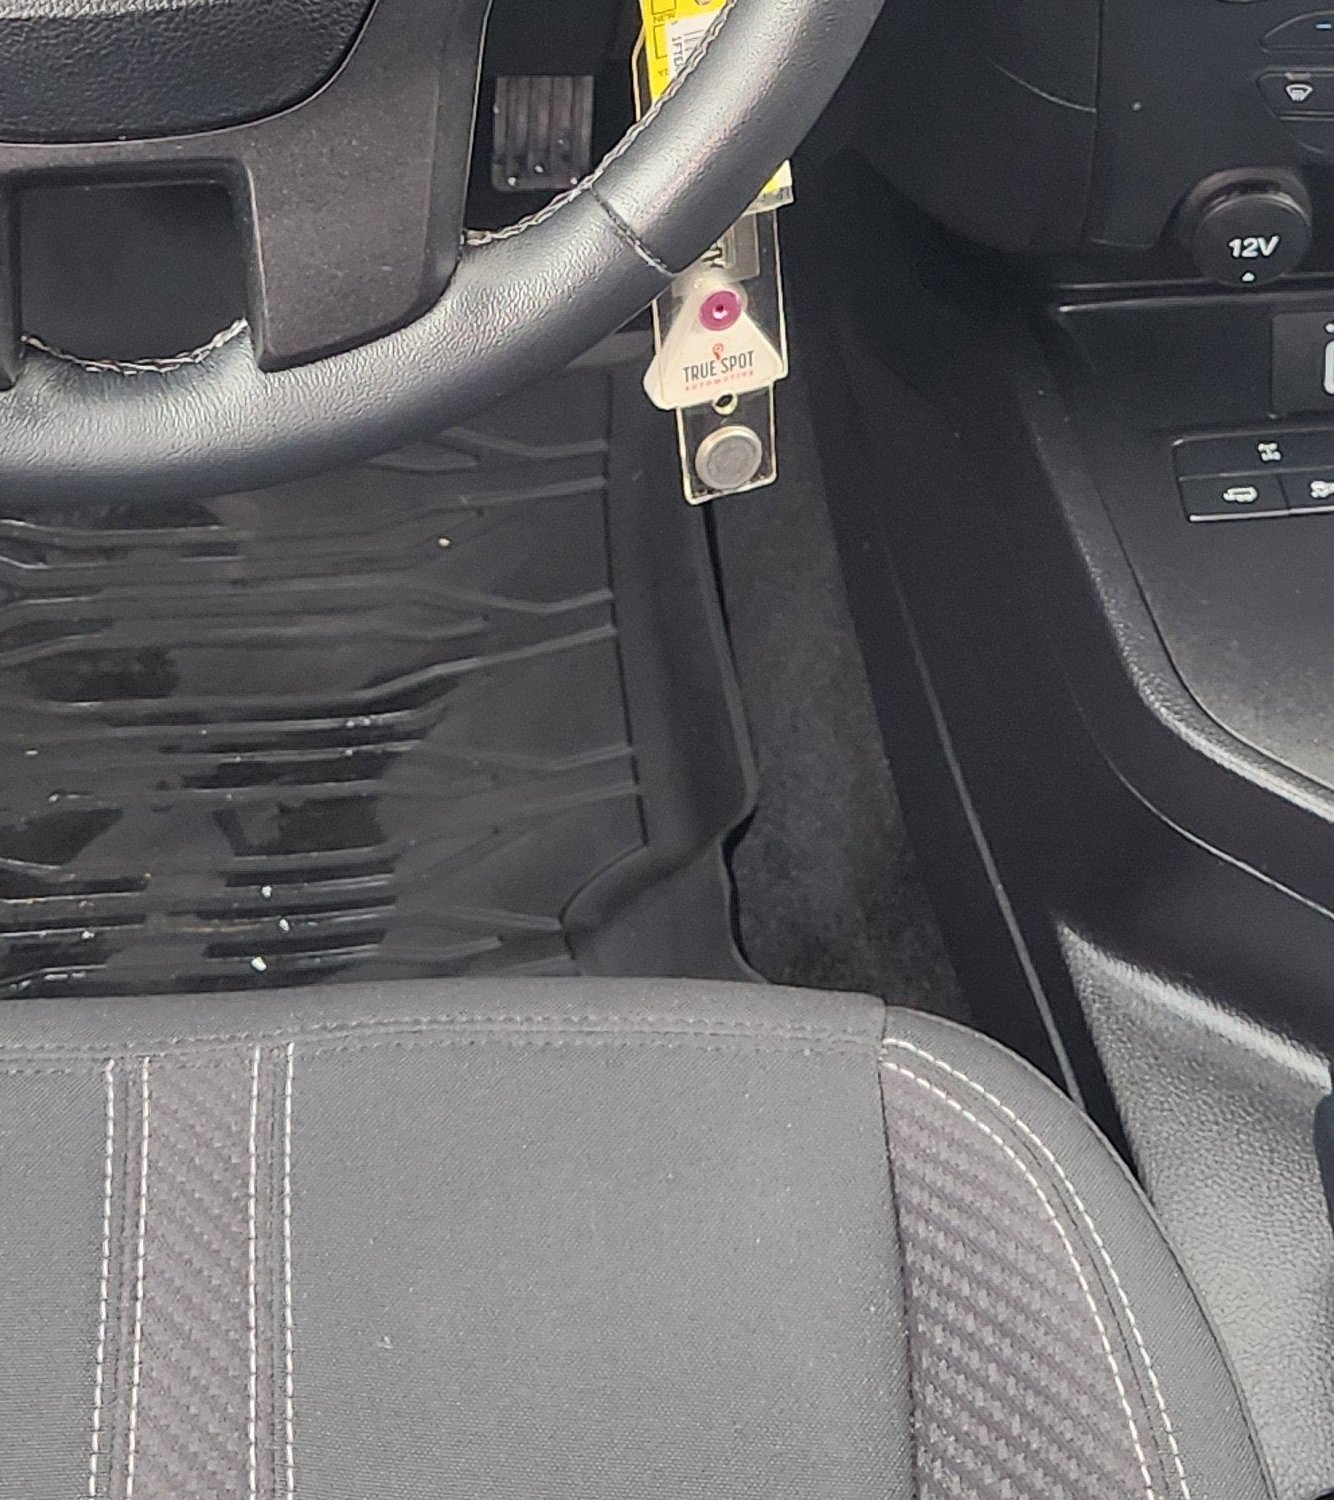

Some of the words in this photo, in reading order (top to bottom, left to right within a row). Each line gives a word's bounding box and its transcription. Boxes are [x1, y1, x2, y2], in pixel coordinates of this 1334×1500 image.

[1227, 234, 1281, 259] 12V
[683, 360, 717, 383] TRUE
[720, 349, 754, 374] SPOT
